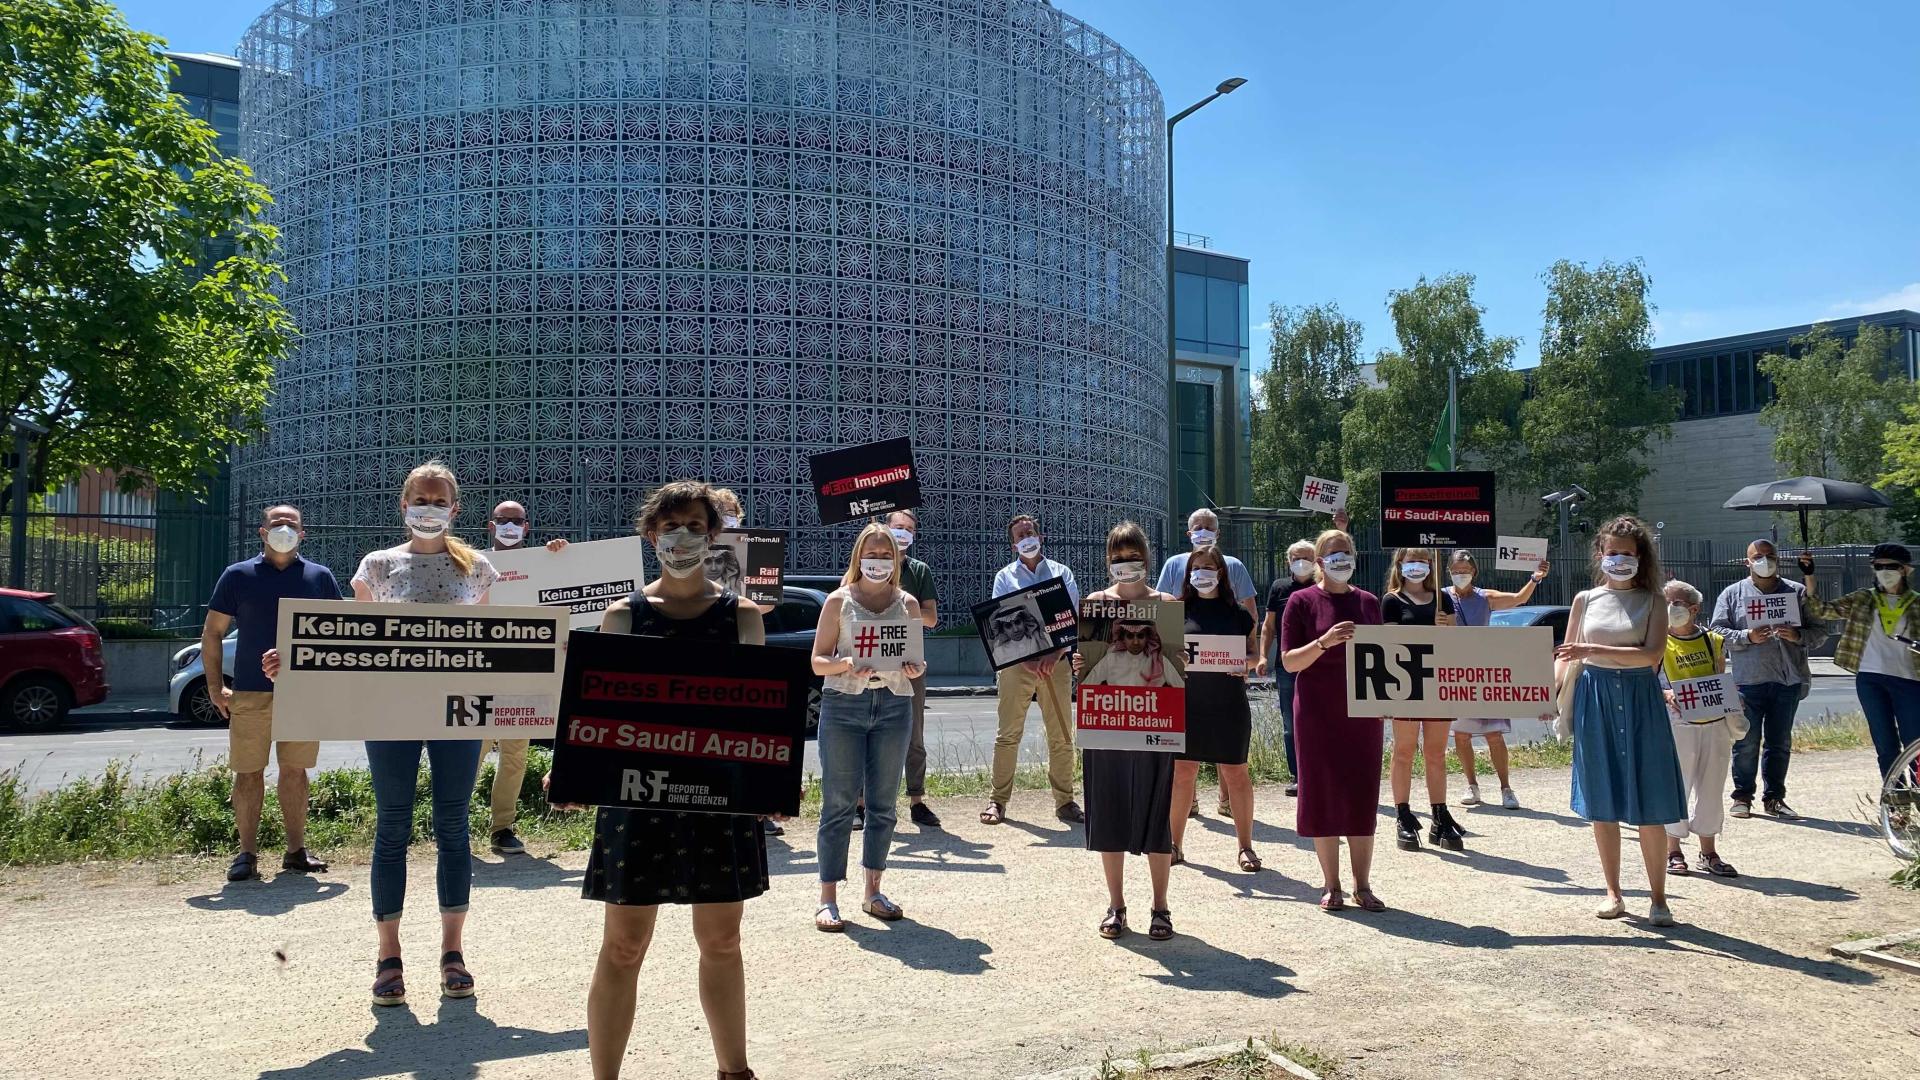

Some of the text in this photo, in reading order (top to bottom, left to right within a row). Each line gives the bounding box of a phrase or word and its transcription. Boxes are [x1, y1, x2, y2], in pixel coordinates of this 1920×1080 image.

[1321, 483, 1339, 495] FREE
[849, 499, 869, 515] RSF
[1319, 494, 1336, 505] RAIF
[1384, 509, 1490, 522] für Saudi-Arabien
[1419, 533, 1436, 545] RSF
[1500, 547, 1519, 560] RSF
[760, 567, 779, 576] Raif
[743, 576, 779, 585] Badawi
[541, 581, 633, 601] Keine Freiheit
[1766, 597, 1786, 607] FREE
[1083, 602, 1158, 619] #FreeRaif
[1767, 608, 1787, 619] RAIF
[298, 616, 551, 640] Keine Freiheit ohne
[880, 625, 907, 639] FREE
[1044, 618, 1075, 634] Badawi
[881, 642, 905, 657] RAIF
[296, 647, 492, 668] Pressefreiheit.
[1354, 642, 1434, 701] RSF
[1438, 667, 1511, 683] REPORTER
[584, 675, 785, 705] Press Freedom
[1439, 685, 1550, 702] OHNE GRENZEN
[1697, 679, 1723, 694] FREE
[1082, 688, 1158, 713] Freiheit
[1702, 693, 1725, 707] RAIF
[446, 695, 493, 726] RSF
[494, 707, 535, 717] REPORTER
[494, 717, 555, 726] OHNE GRENZEN
[1081, 713, 1173, 728] für Raif Badawi
[569, 719, 790, 762] for Saudi Arabia
[1146, 734, 1161, 745] RSF
[620, 769, 669, 802] RSF
[668, 784, 709, 795] REPORTER
[668, 794, 728, 806] OHNE GRENZEN
